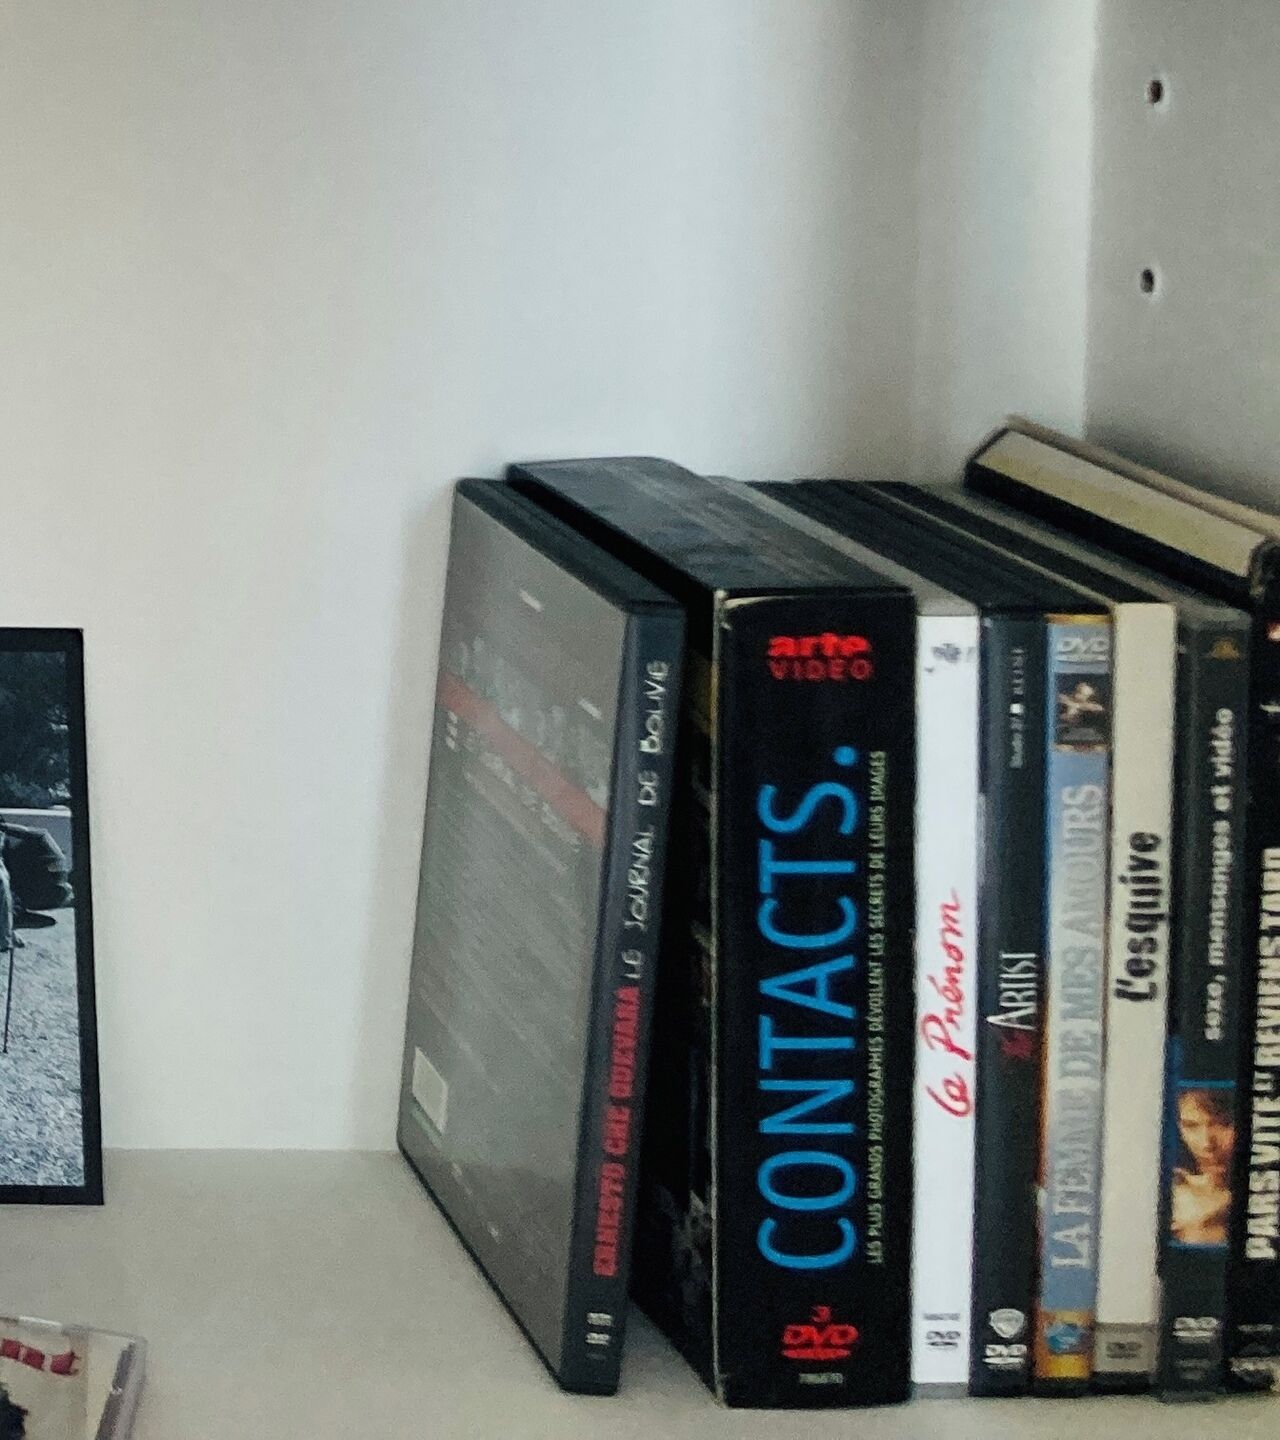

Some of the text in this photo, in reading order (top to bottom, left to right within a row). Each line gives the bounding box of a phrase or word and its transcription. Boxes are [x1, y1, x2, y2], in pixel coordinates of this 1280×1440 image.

[767, 632, 872, 658] arte
[768, 659, 874, 681] VIDEO
[641, 660, 670, 754] BOLIVIE
[637, 770, 660, 807] DE
[866, 750, 888, 802] IMAGES
[866, 805, 887, 848] LEURS
[1207, 707, 1236, 966] mensonges et vidéo
[624, 831, 657, 930] JOURNAL
[1060, 782, 1105, 935] AMOURS
[866, 874, 887, 929] SECRETS
[1114, 830, 1172, 1003] L'esquive
[620, 949, 644, 980] LE
[920, 888, 974, 1063] Prénom
[756, 745, 860, 1271] CONTACTS.
[1058, 1030, 1101, 1080] DE
[865, 1036, 886, 1141] PHOTOGRAPHES
[1245, 936, 1280, 1260] PARS VITE REVIENS
[602, 1105, 632, 1157] CHE
[865, 1145, 886, 1199] GRANDS
[865, 1204, 886, 1236] PLUS
[1050, 1220, 1090, 1269] LA
